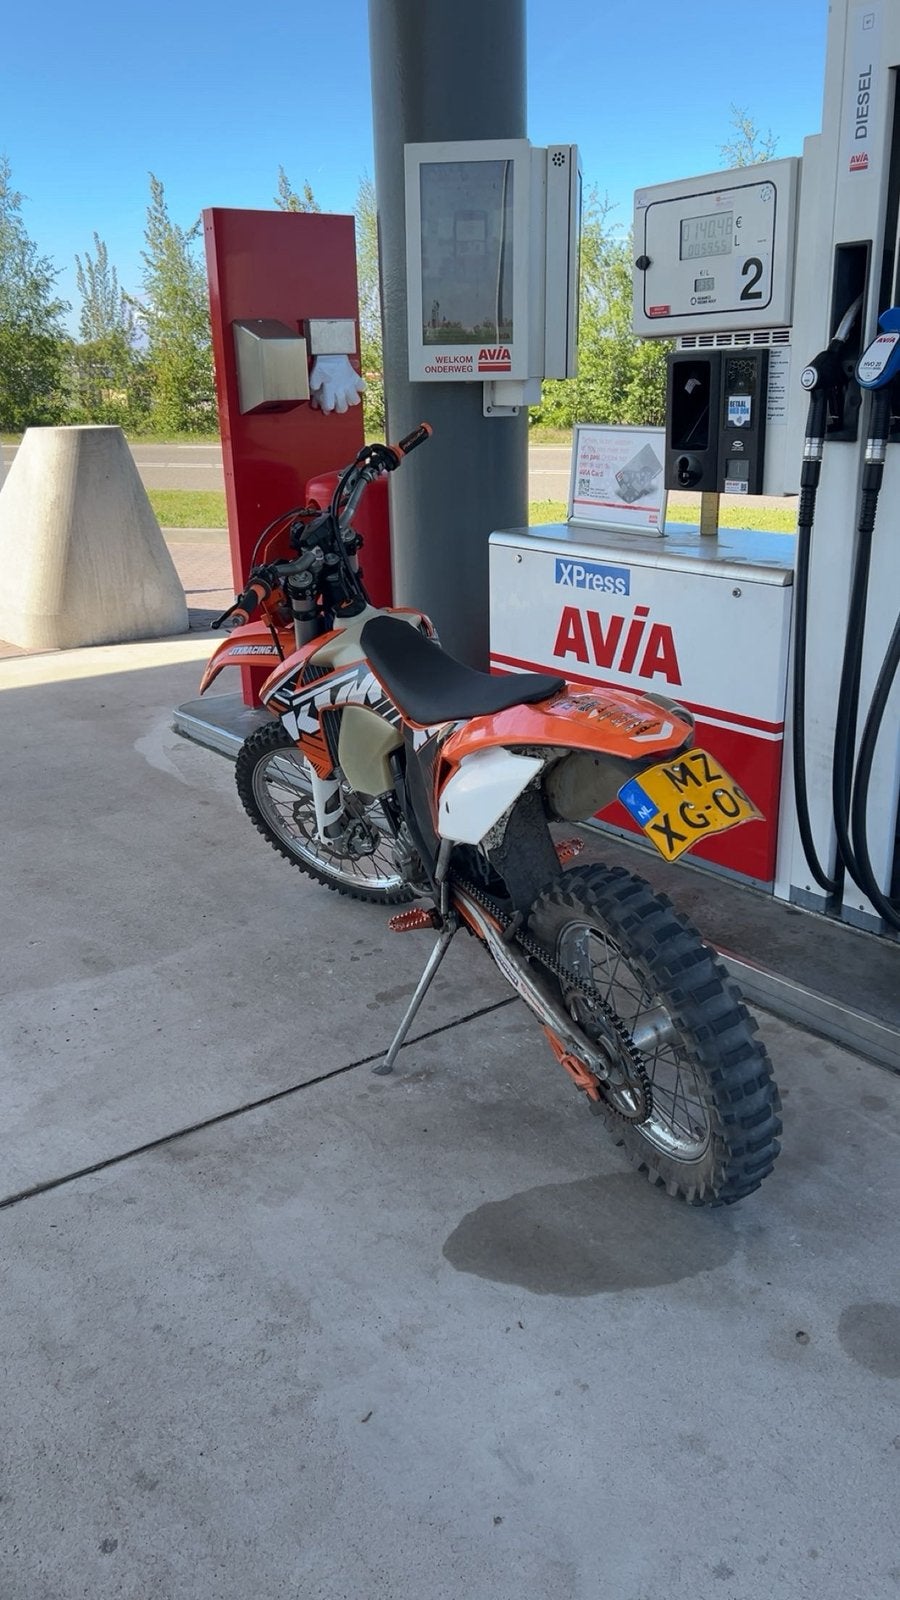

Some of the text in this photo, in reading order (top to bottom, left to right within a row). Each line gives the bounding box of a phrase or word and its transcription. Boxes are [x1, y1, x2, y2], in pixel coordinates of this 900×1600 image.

[855, 64, 872, 140] DIESEL
[736, 216, 742, 228] €
[734, 235, 740, 246] L
[740, 257, 763, 301] 2
[425, 365, 473, 373] ONDERWEG
[559, 563, 627, 594] XPress
[662, 753, 723, 793] MZ
[638, 805, 653, 820] NL
